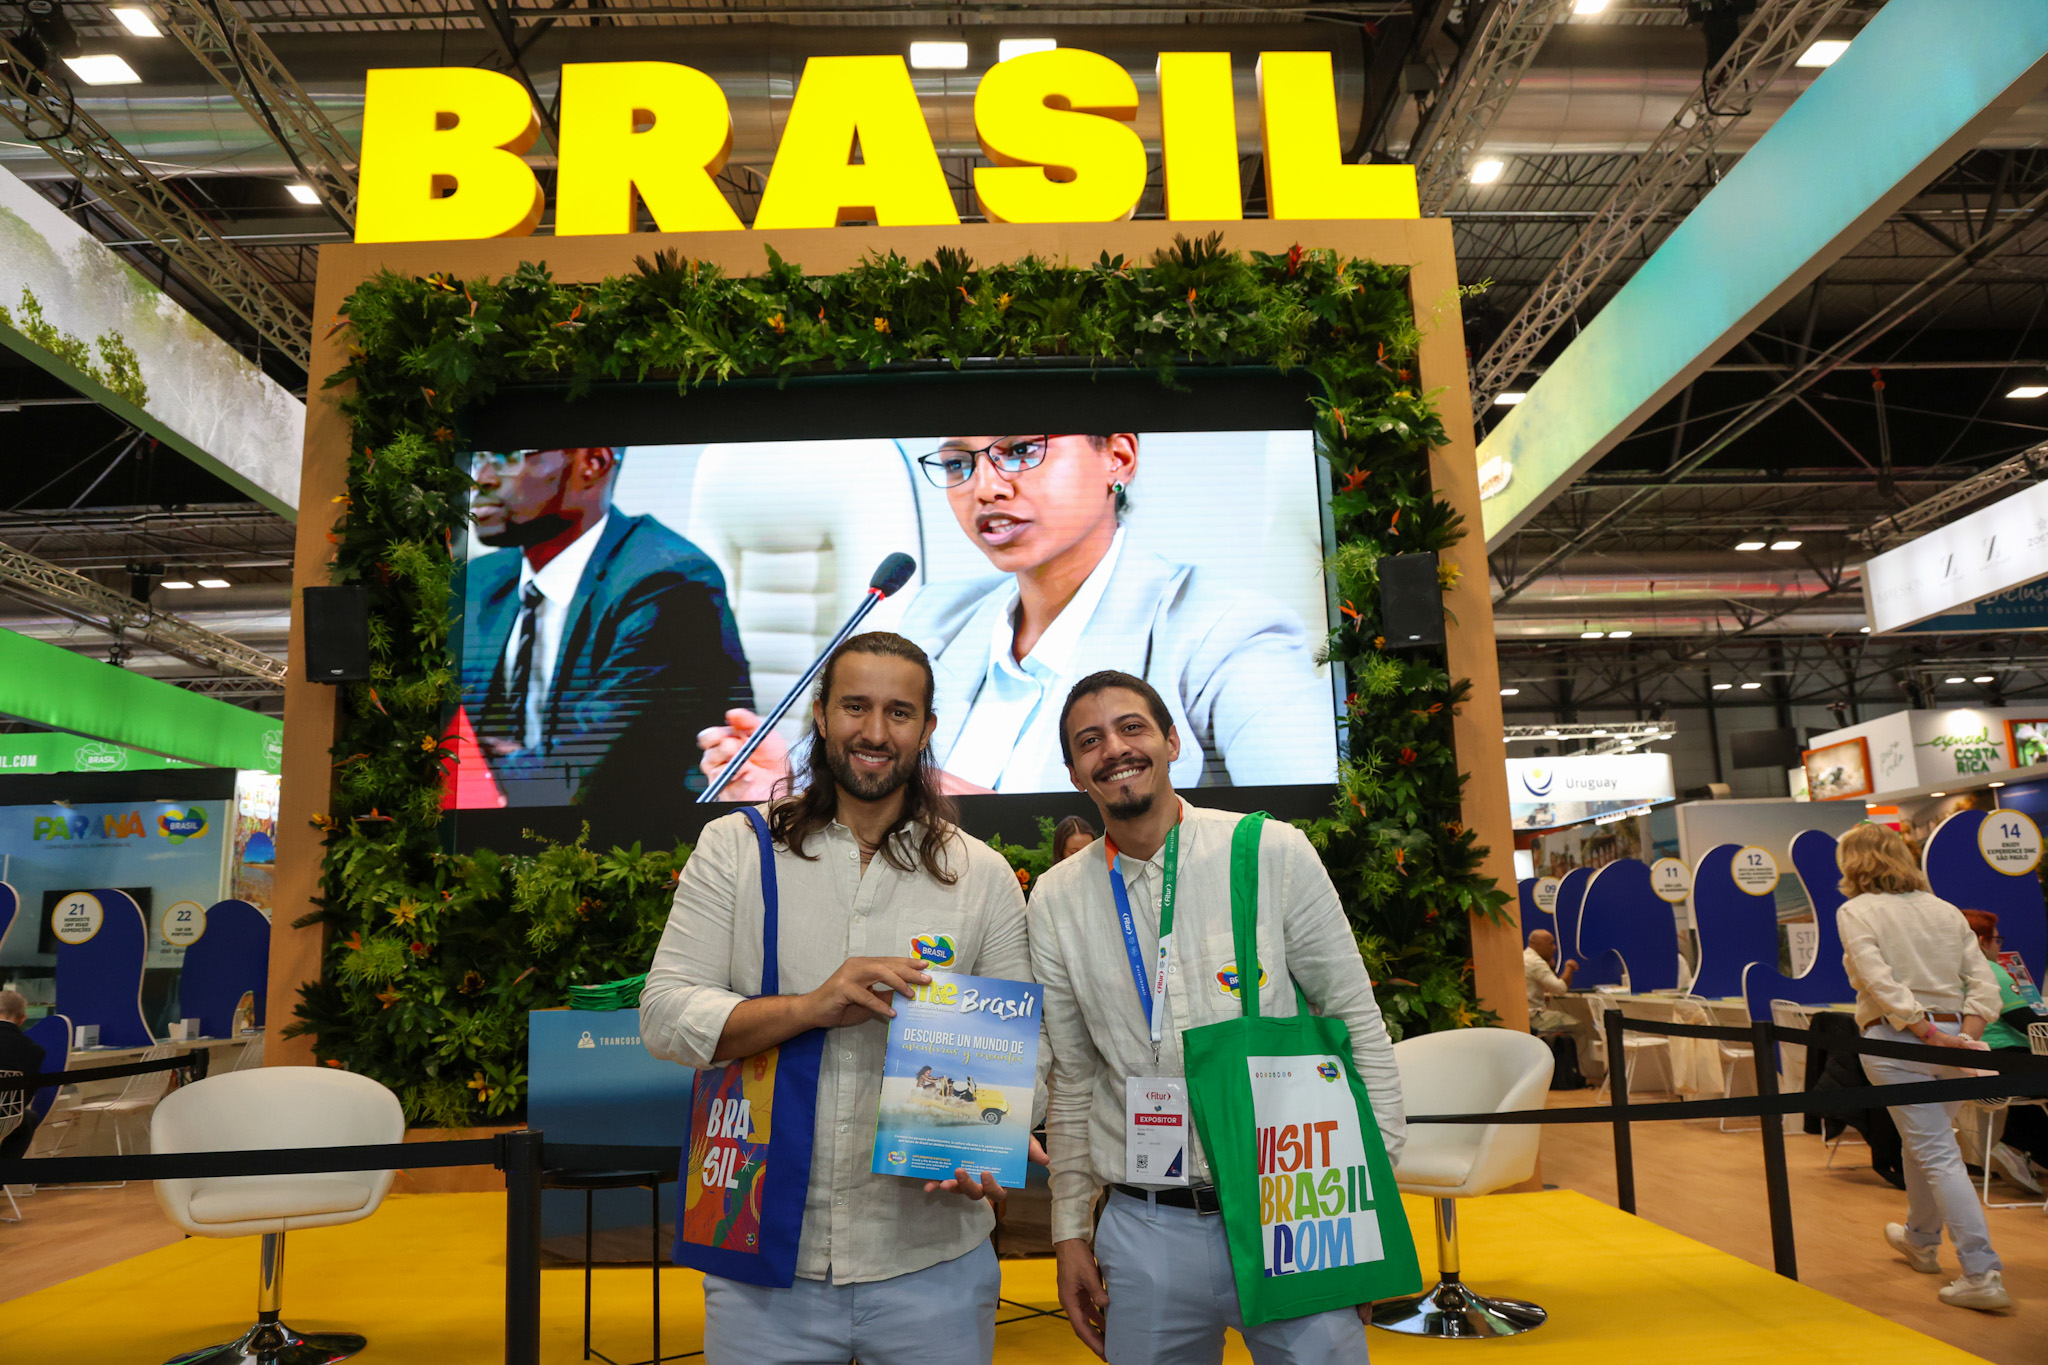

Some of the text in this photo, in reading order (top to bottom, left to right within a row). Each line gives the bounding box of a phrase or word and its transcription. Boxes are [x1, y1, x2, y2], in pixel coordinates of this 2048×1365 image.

[355, 48, 1420, 244] BRASIL
[88, 756, 116, 764] BRASIL
[1954, 747, 2000, 760] COSTA
[1956, 760, 1990, 774] RICA
[1566, 778, 1617, 790] Uruguay
[33, 810, 146, 840] PARANÁ
[170, 822, 199, 831] BRASIL
[2001, 823, 2021, 838] 14
[1747, 854, 1762, 866] 12
[1665, 868, 1678, 877] 11
[1545, 885, 1556, 893] 09
[69, 904, 85, 915] 21
[176, 911, 191, 921] 22
[922, 947, 947, 959] BRASIL
[960, 989, 1035, 1020] Brasil
[600, 1036, 641, 1046] TRANCOSO
[904, 1028, 1024, 1054] DESCUBRE UN MUNDO DE
[902, 1041, 1024, 1065] aventuras y encantos
[706, 1098, 751, 1140] BRA
[1139, 1116, 1177, 1124] EXPOSITOR
[1257, 1120, 1338, 1175] VISIT
[702, 1146, 739, 1189] SIL
[1260, 1165, 1377, 1226] BRASIL
[1264, 1217, 1355, 1278] .COM
